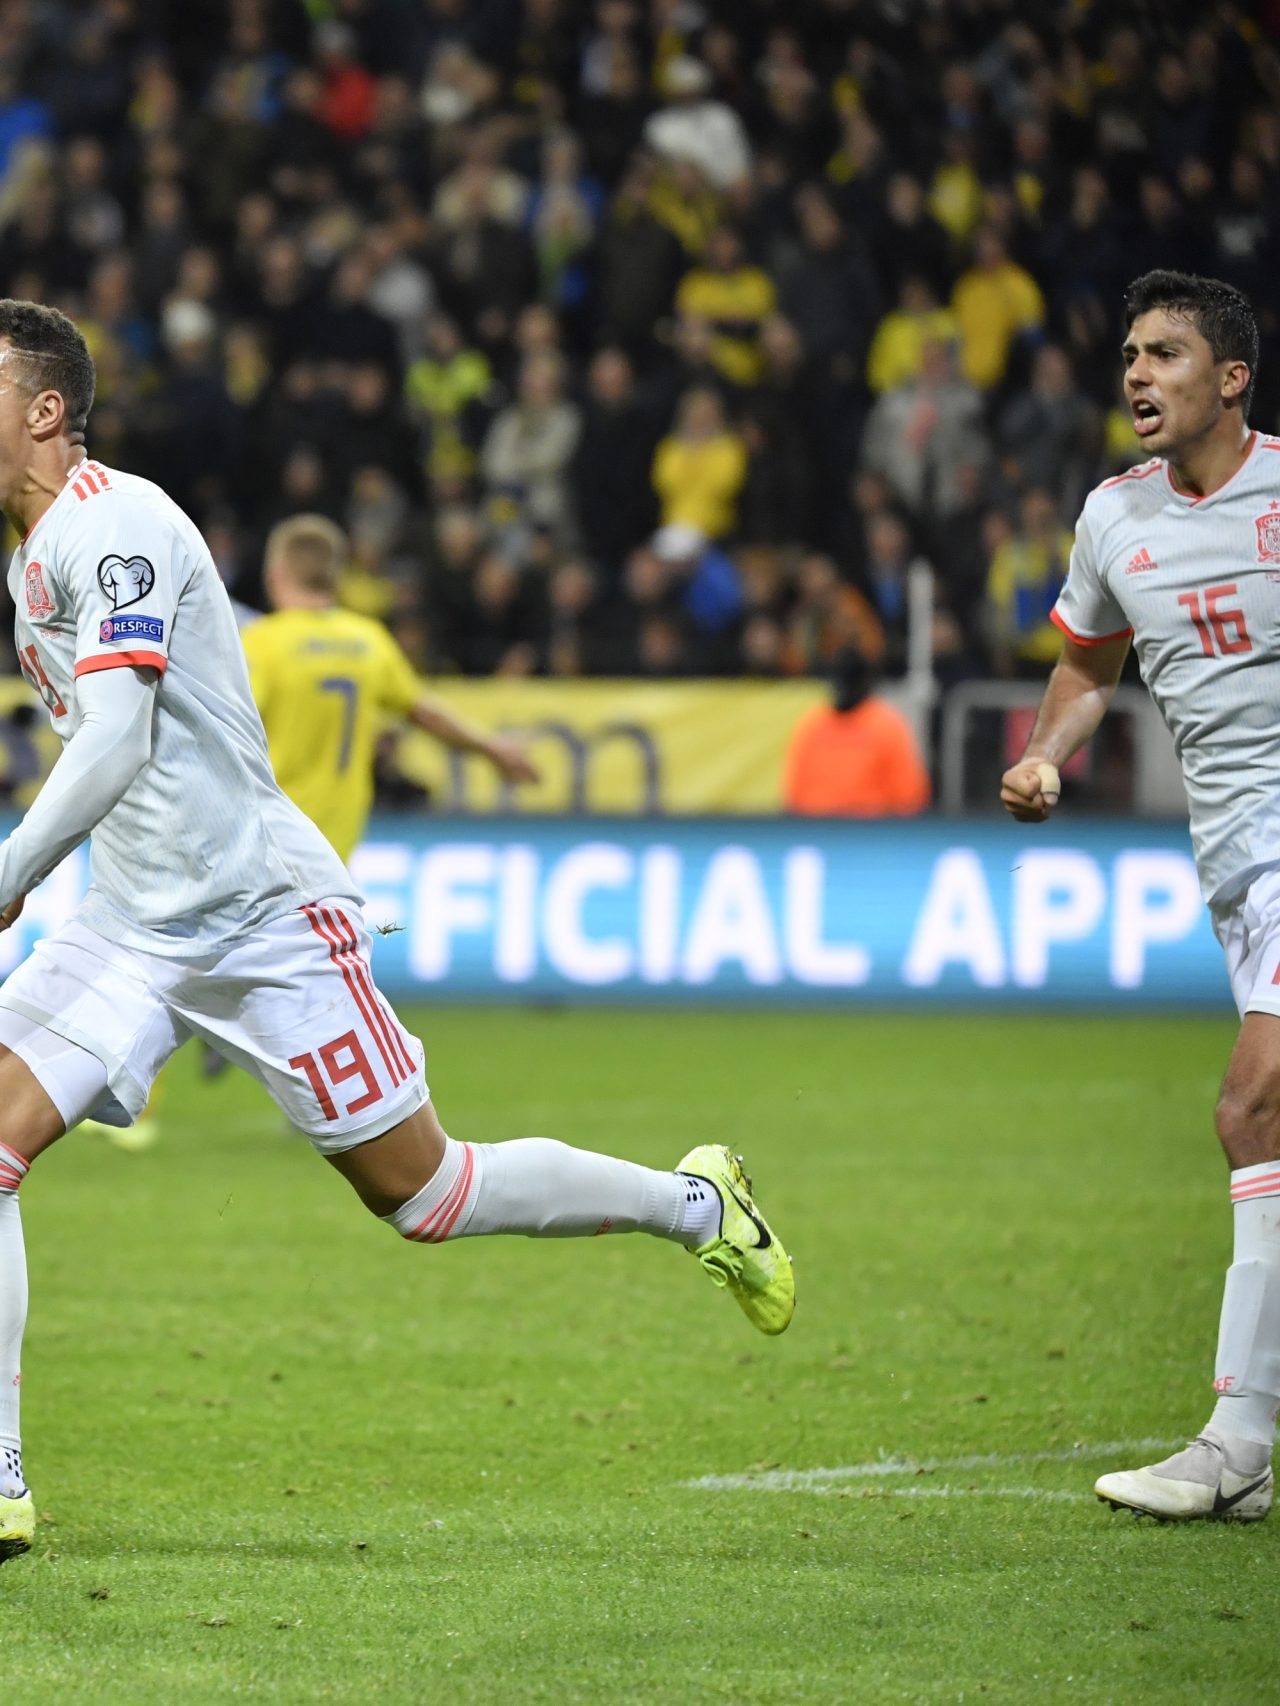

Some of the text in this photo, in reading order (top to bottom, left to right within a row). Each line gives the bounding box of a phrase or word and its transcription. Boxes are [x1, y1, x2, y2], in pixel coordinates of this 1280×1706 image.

[1125, 561, 1158, 575] adidas
[113, 620, 163, 635] RESPECT
[1178, 583, 1252, 658] 16
[318, 678, 355, 776] 7
[346, 840, 870, 986] FFICIAL
[901, 846, 1201, 990] APP
[288, 1029, 384, 1121] 19
